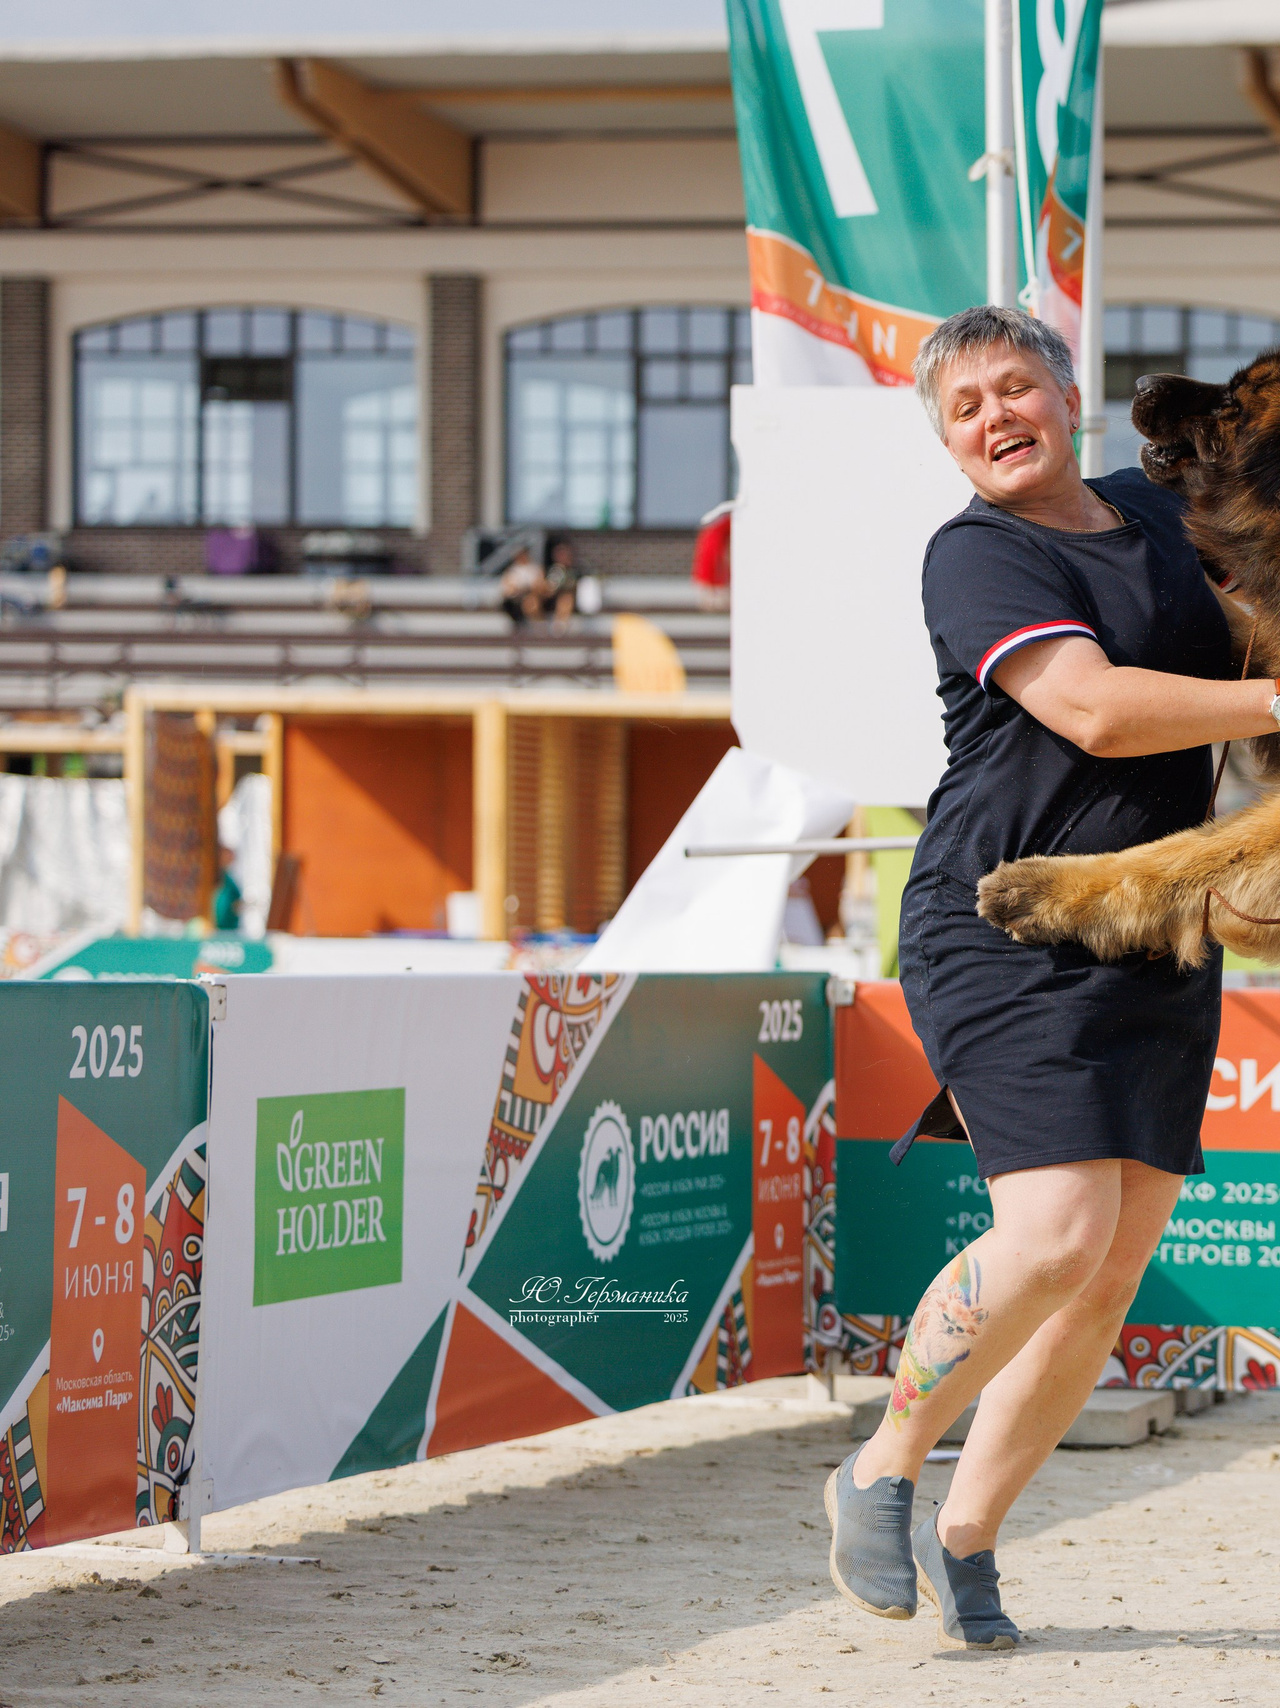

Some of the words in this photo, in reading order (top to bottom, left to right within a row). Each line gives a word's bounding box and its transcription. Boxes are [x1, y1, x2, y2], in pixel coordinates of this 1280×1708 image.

[758, 1000, 803, 1043] 2025
[69, 1025, 144, 1079] 2025
[639, 1108, 730, 1164] РОССИЯ
[297, 1137, 385, 1193] GREEN
[1180, 1180, 1217, 1202] КФ
[275, 1195, 387, 1257] HOLDER
[1163, 1217, 1276, 1242] МОСКВЫ
[64, 1260, 134, 1300] ИЮНЯ
[56, 1371, 102, 1392] Московская
[103, 1368, 135, 1387] область,
[56, 1392, 103, 1414] «Максима
[104, 1388, 134, 1411] Парк»
